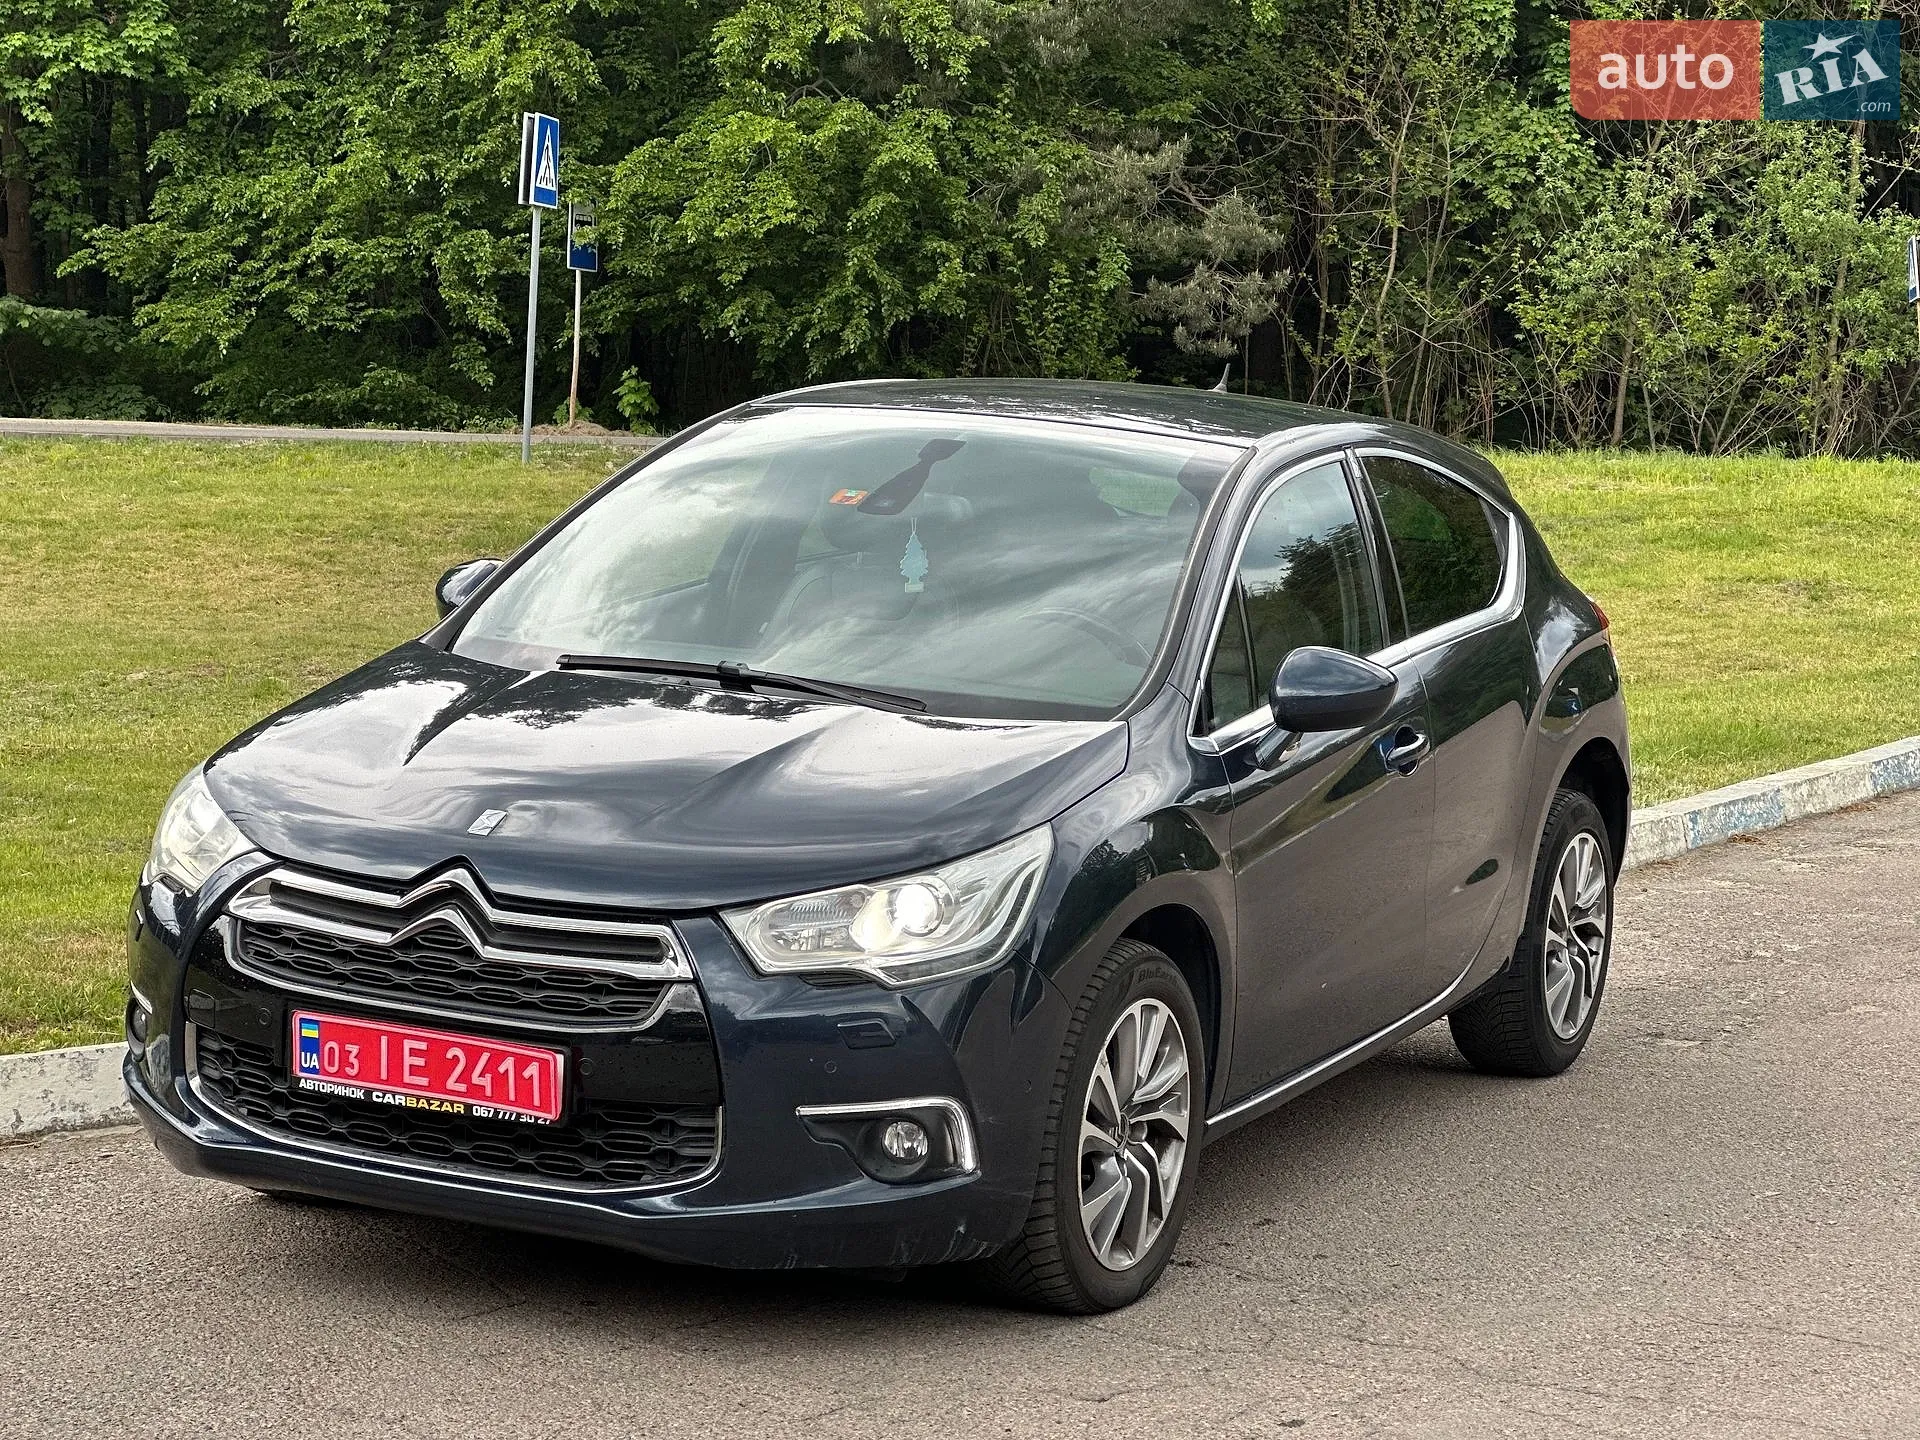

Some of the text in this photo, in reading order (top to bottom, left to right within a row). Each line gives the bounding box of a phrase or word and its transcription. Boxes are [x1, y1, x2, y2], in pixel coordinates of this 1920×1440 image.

[301, 1052, 319, 1069] UA
[323, 1035, 541, 1108] 03 IE 2411
[299, 1078, 365, 1100] АВТОРИНОК
[372, 1091, 465, 1115] CARBAZAR
[472, 1105, 494, 1118] 067
[496, 1109, 517, 1121] 777
